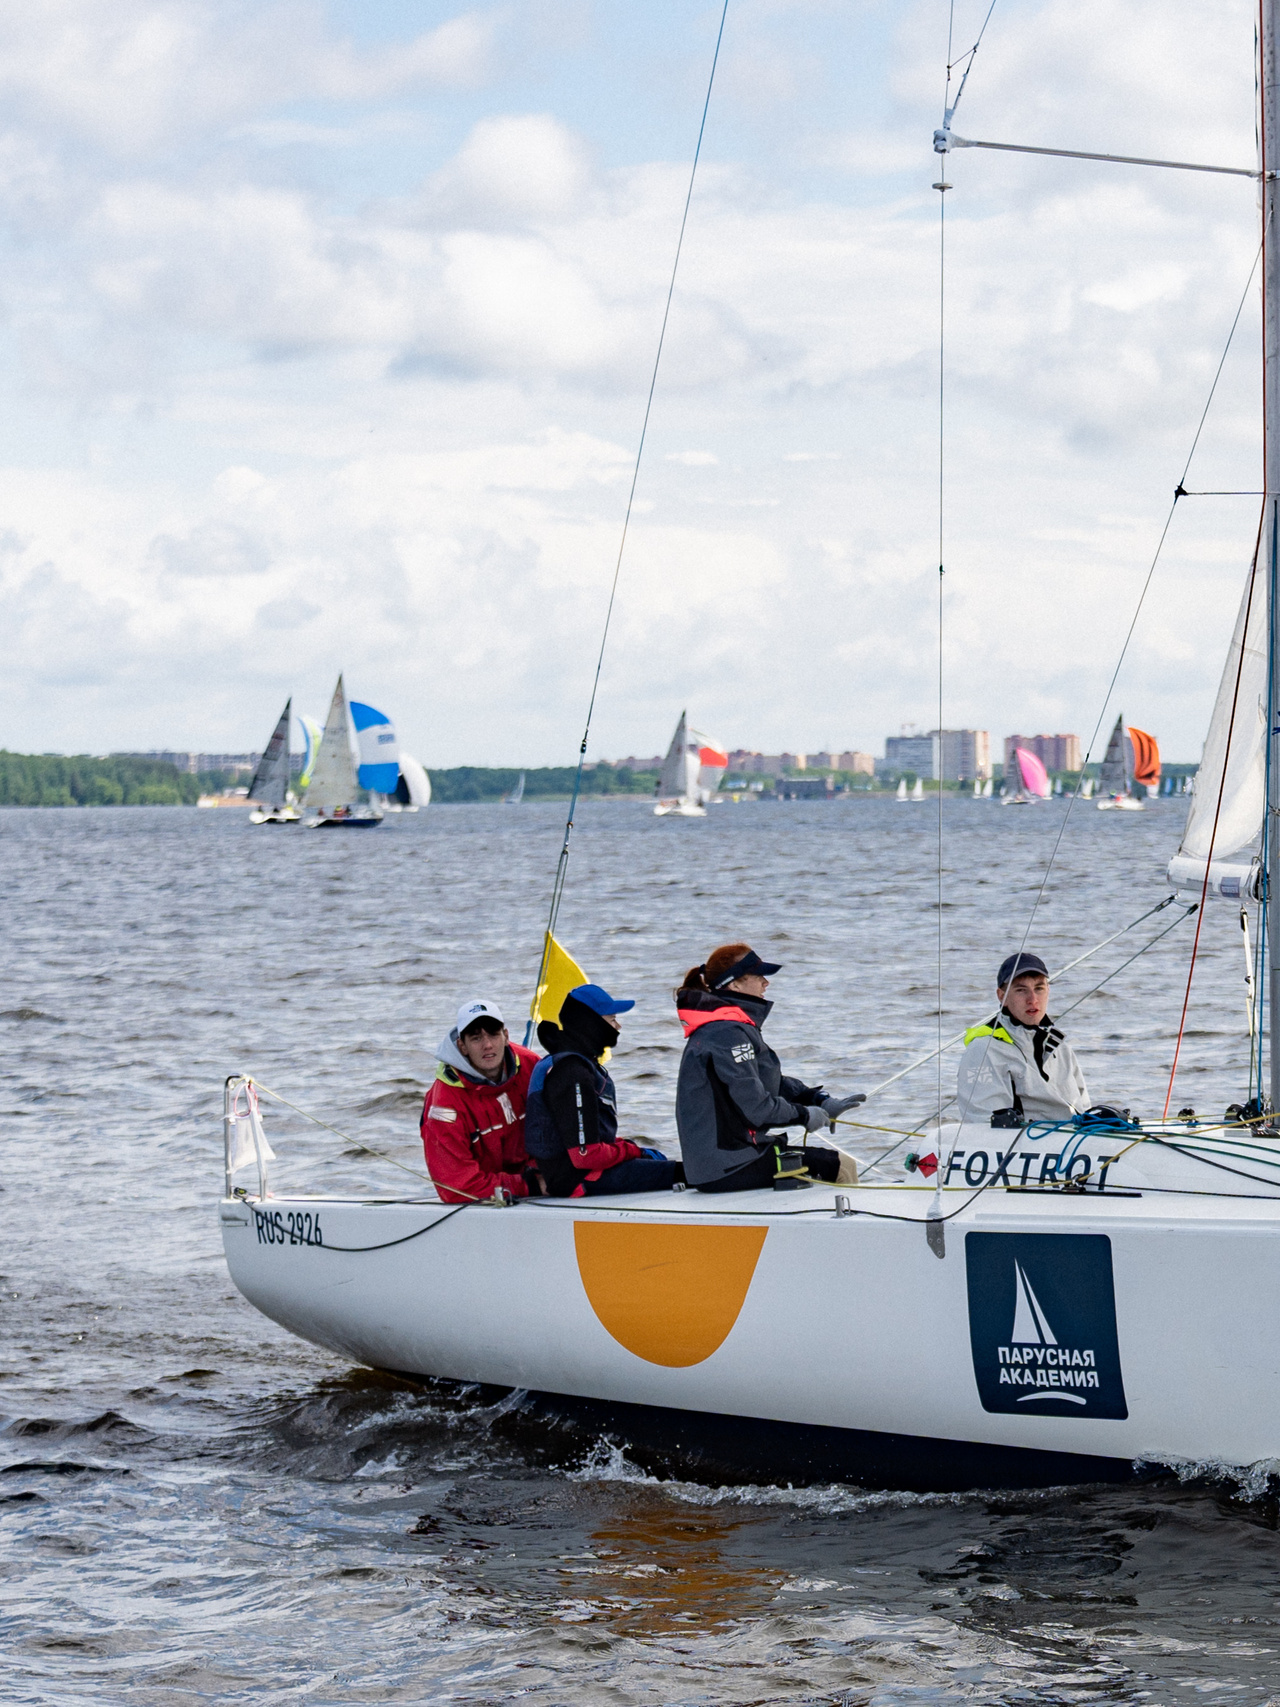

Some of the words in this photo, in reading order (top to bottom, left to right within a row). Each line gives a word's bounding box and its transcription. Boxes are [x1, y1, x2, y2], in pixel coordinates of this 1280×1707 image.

[943, 1150, 1120, 1191] FOXTROT
[255, 1211, 285, 1245] RUS
[287, 1212, 323, 1246] 2926
[998, 1347, 1096, 1367] ПАРУСНАЯ
[999, 1368, 1100, 1388] АКАДЕМИЯ
